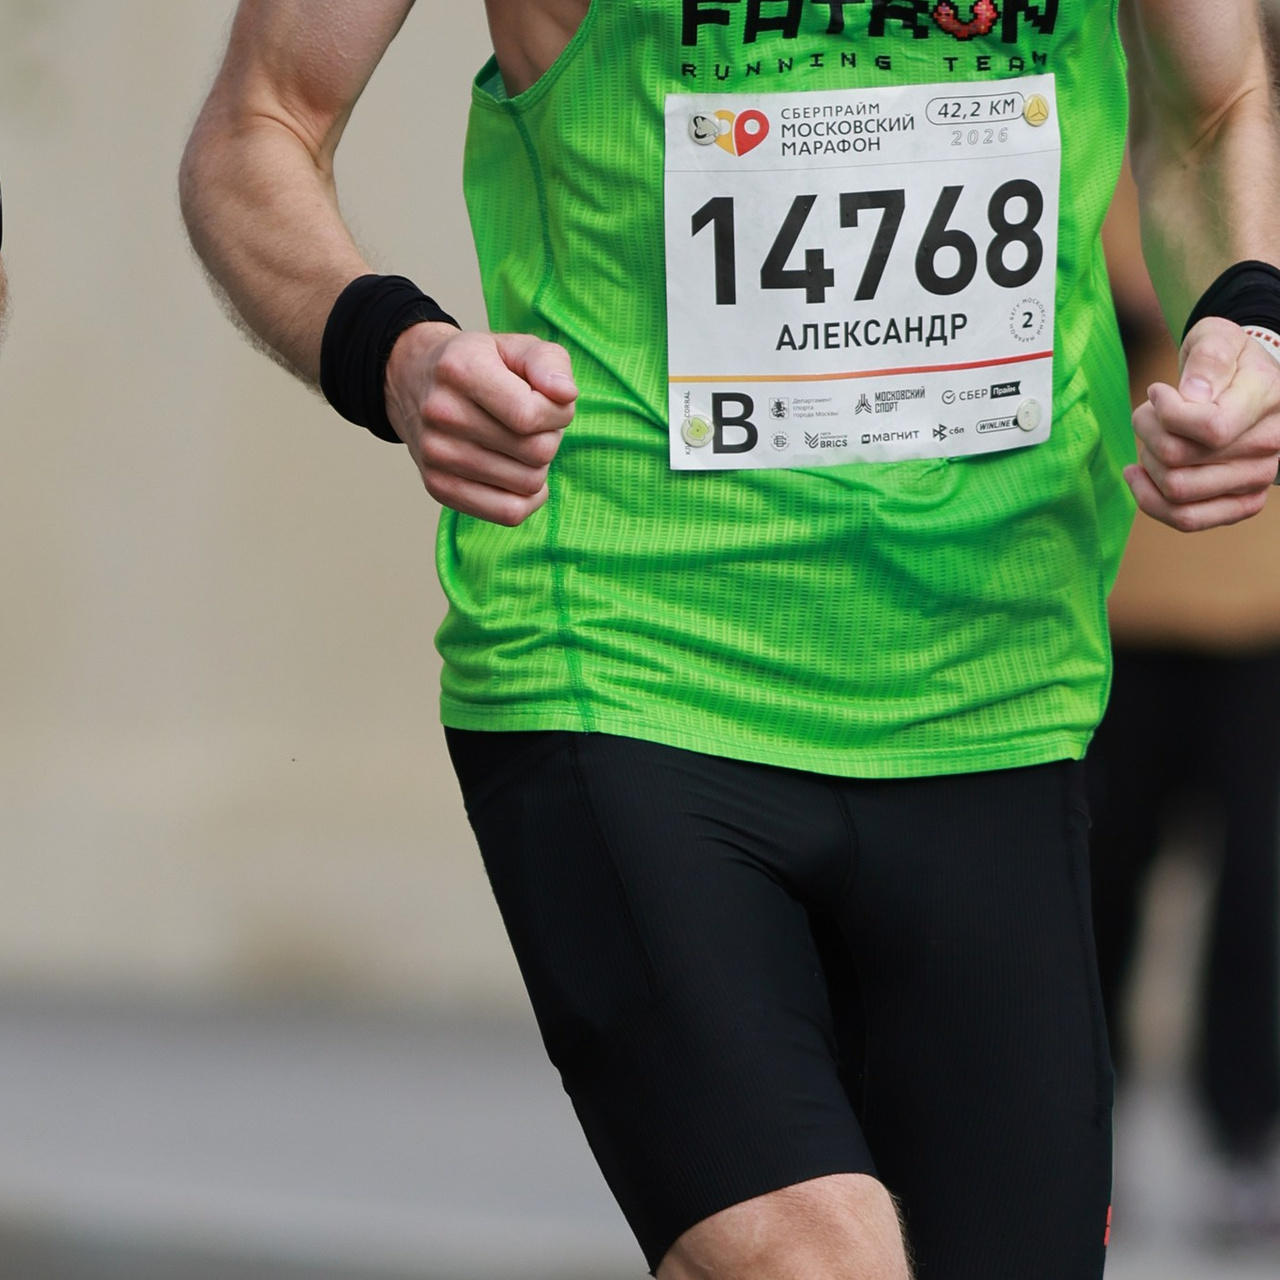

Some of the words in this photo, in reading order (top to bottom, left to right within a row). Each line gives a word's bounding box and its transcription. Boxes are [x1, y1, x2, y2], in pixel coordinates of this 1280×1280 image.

[682, 52, 891, 80] RUNNING
[944, 51, 1046, 71] TEAM
[781, 102, 880, 120] СБЕРПРАЙМ
[937, 101, 981, 120] 42,2
[781, 114, 915, 138] МОСКОВСКИЙ
[951, 127, 1008, 146] 2026
[781, 137, 881, 156] МАРАФОН
[691, 178, 1043, 305] 14768
[1022, 312, 1033, 329] 2
[775, 313, 968, 351] АЛЕКСАНДР
[874, 386, 925, 402] МОСКОВСКИЙ
[959, 388, 988, 401] СБЕР
[875, 401, 899, 414] СПОРТ
[979, 420, 1010, 431] WINLINE
[820, 439, 848, 448] BRICS
[872, 430, 920, 442] магнит
